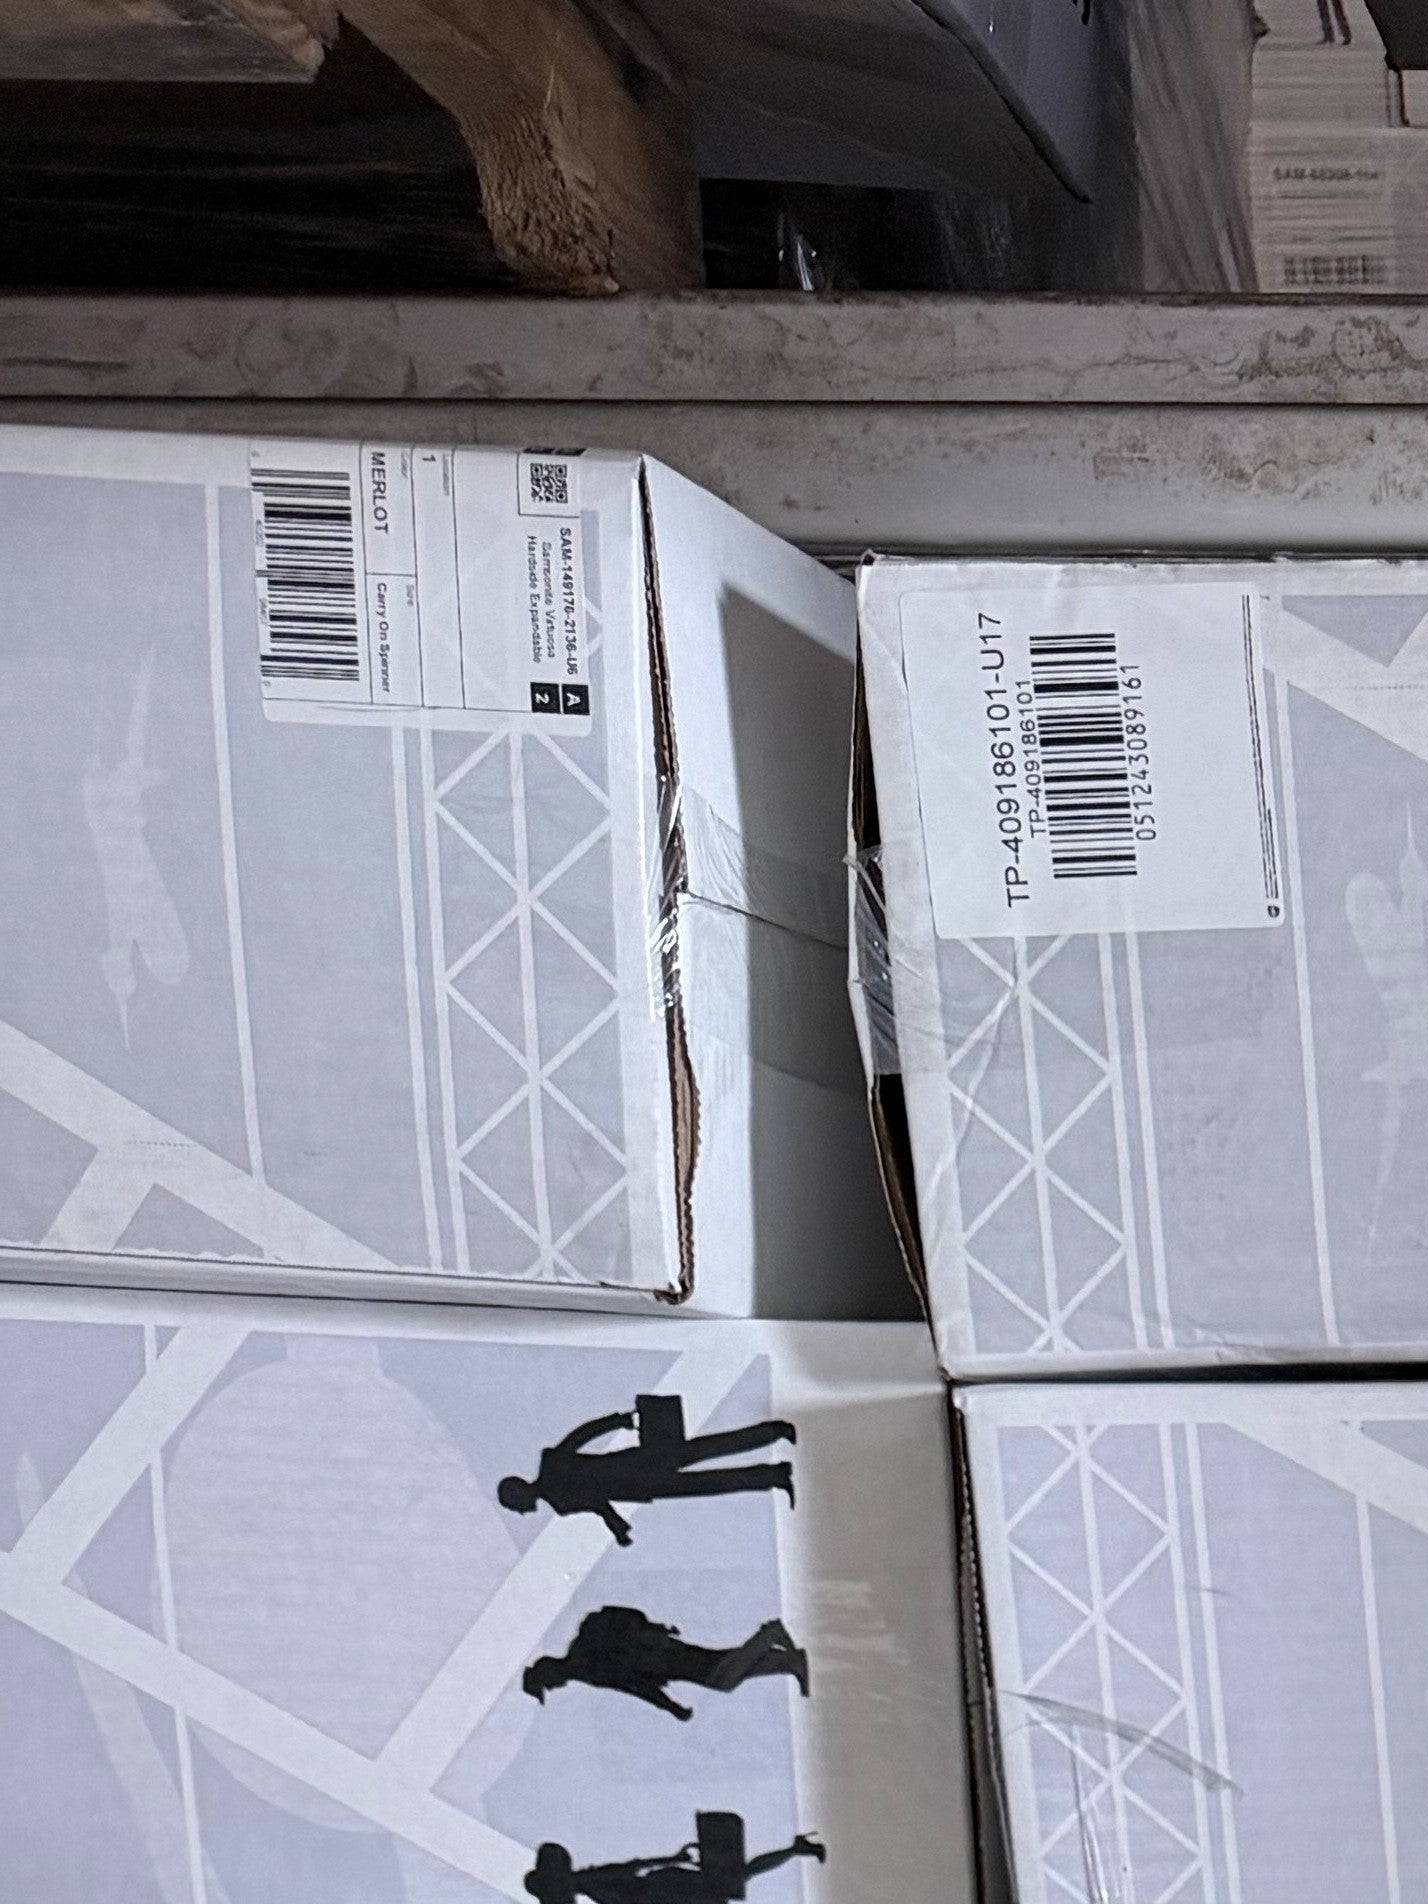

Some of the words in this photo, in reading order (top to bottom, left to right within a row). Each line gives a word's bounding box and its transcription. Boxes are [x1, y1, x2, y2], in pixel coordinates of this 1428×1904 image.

[371, 451, 390, 535] MERLOT
[375, 582, 388, 618] Carry
[379, 620, 389, 642] On
[977, 612, 1030, 908] TP-409186101-U17
[1015, 679, 1047, 838] TP-409186101
[1119, 664, 1157, 841] 051243089161
